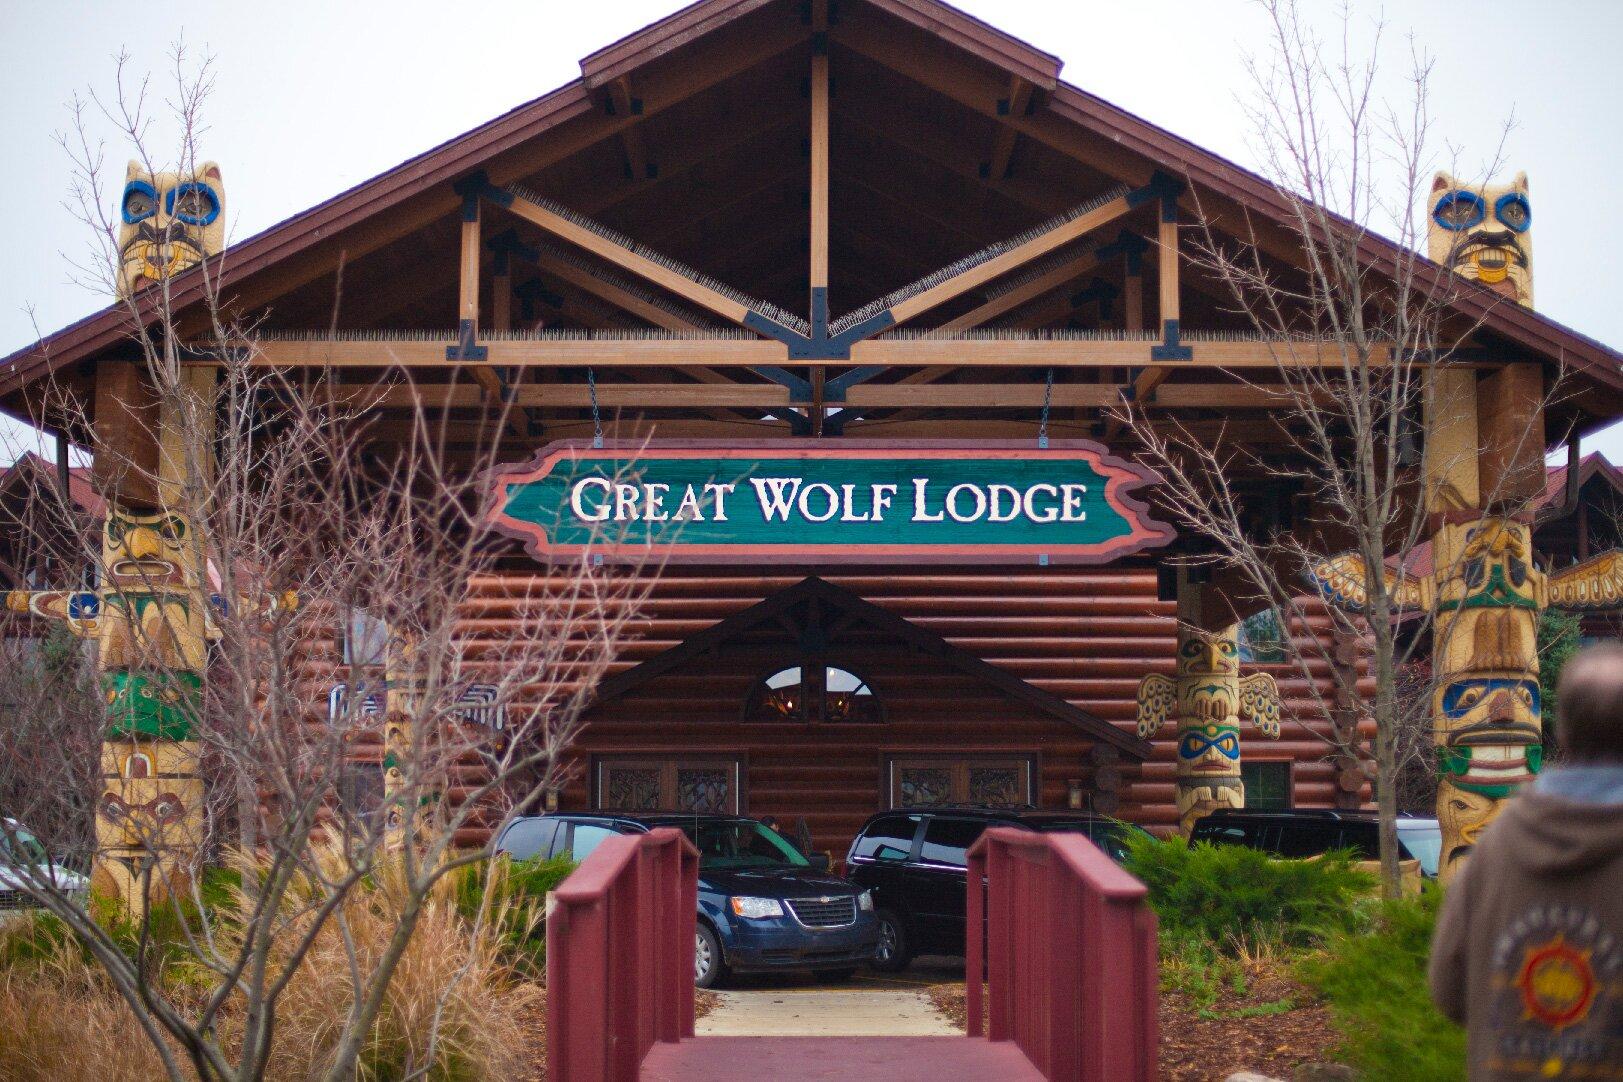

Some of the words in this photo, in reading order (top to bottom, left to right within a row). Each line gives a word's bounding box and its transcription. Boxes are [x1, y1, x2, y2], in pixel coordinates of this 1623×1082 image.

[571, 477, 736, 522] GREAT
[749, 477, 898, 522] WOLF
[911, 478, 1088, 523] LODGE
